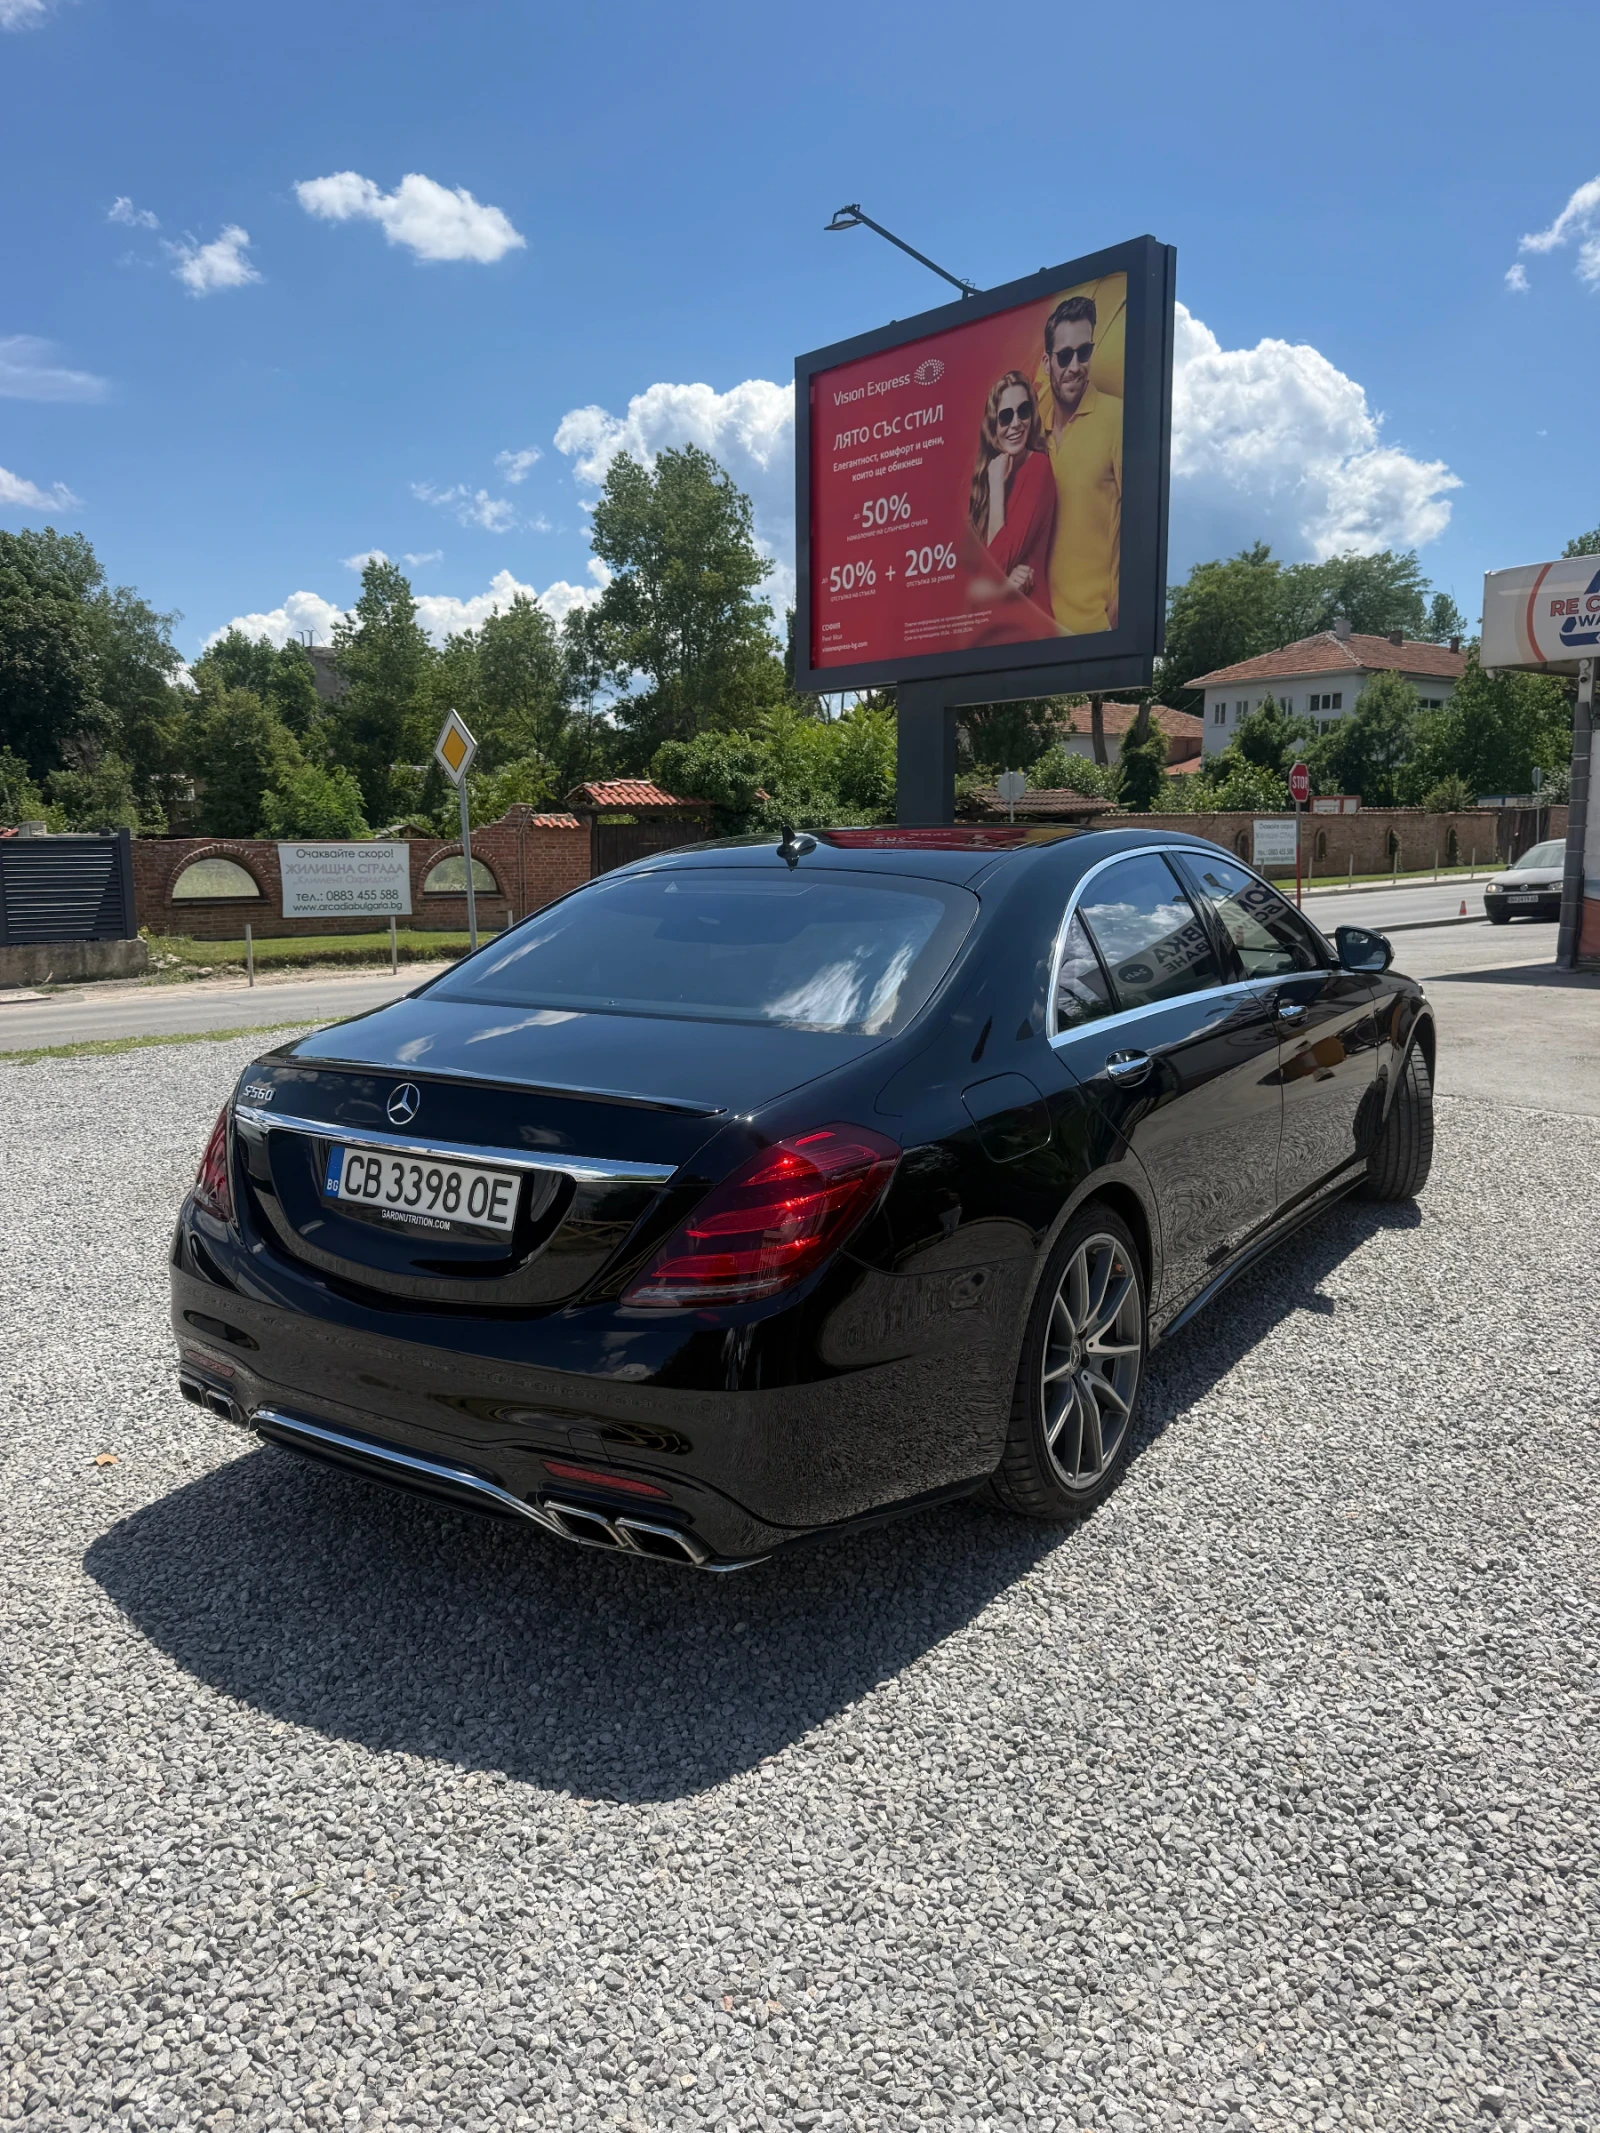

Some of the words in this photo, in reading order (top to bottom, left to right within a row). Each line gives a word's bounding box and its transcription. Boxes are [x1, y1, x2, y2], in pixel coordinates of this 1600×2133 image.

[833, 387, 865, 406] Vision
[867, 374, 911, 395] Express
[832, 426, 869, 451] ЛЯТО
[873, 416, 901, 439] СЪС
[904, 404, 944, 431] СТИЛ
[833, 454, 879, 472] Елегантност,
[880, 443, 915, 459] комфорт
[915, 441, 921, 450] и
[922, 436, 945, 449] цени,
[852, 470, 874, 482] които
[875, 465, 887, 477] ще
[887, 457, 923, 473] обикнеш
[861, 492, 911, 528] 50%
[829, 559, 876, 593] 50%
[904, 541, 957, 578] 20%
[1550, 597, 1580, 617] RE
[1292, 775, 1309, 790] STOP
[296, 848, 355, 859] Очаквайте
[357, 848, 394, 860] скоро!
[285, 863, 355, 875] ЖИЛИЩНА
[357, 863, 405, 874] СГРАДА
[295, 891, 323, 902] тел.:
[326, 890, 354, 901] 0883
[357, 889, 377, 900] 455
[380, 889, 399, 900] 588
[326, 1179, 339, 1192] BG
[345, 1155, 382, 1198] CB
[385, 1162, 461, 1213] 3398
[381, 1209, 451, 1231] GARDNUTRITION.COM
